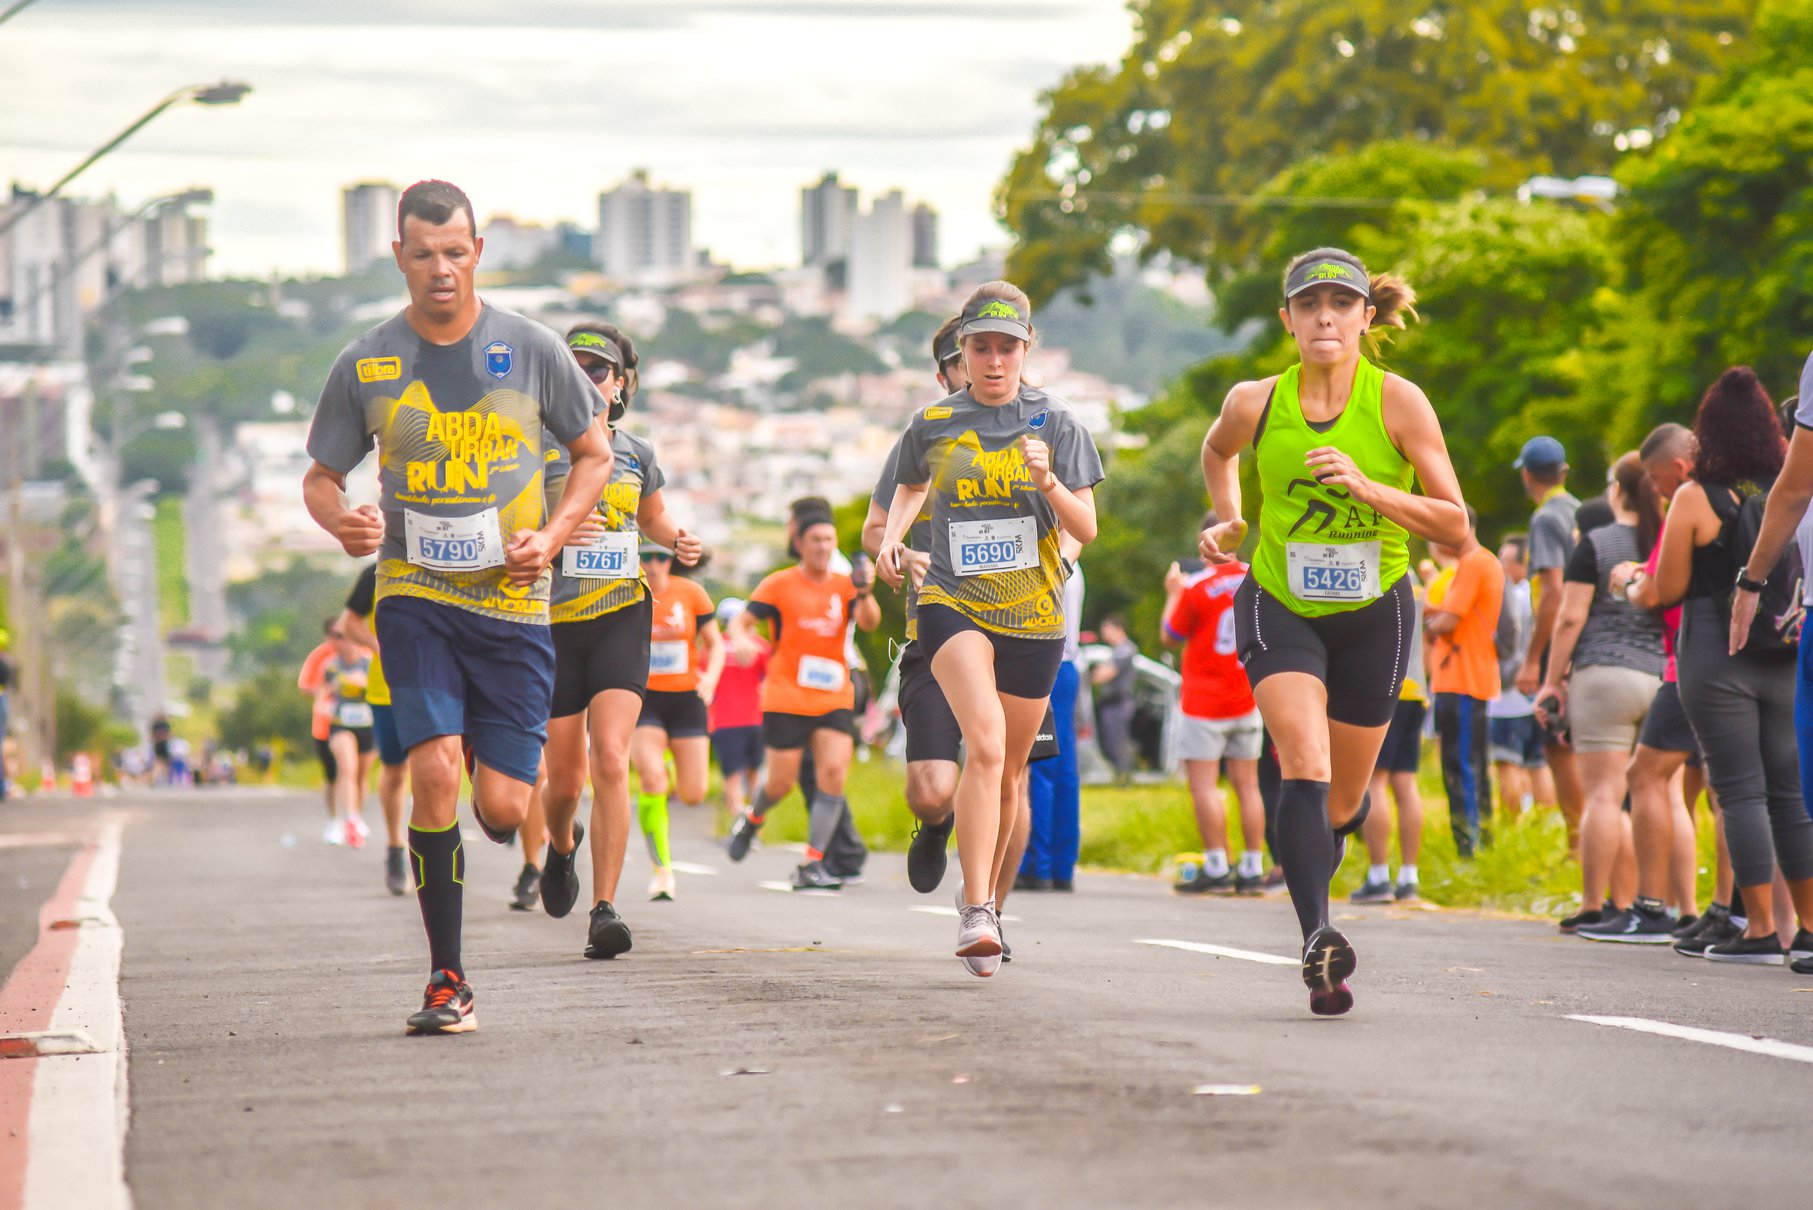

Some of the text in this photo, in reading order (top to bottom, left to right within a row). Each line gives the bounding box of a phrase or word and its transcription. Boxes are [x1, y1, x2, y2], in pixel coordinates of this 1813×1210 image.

[426, 411, 502, 442] ABDA
[450, 438, 519, 463] URBAN
[971, 448, 1023, 468] ABDA
[406, 460, 488, 494] RUN
[956, 478, 1012, 501] RUN
[476, 530, 485, 552] 5KM
[1015, 534, 1023, 554] 5KM
[1329, 529, 1379, 539] Running
[423, 539, 476, 560] 5790
[579, 551, 620, 569] 5761
[965, 542, 1014, 564] 5690
[1307, 568, 1360, 590] 5426
